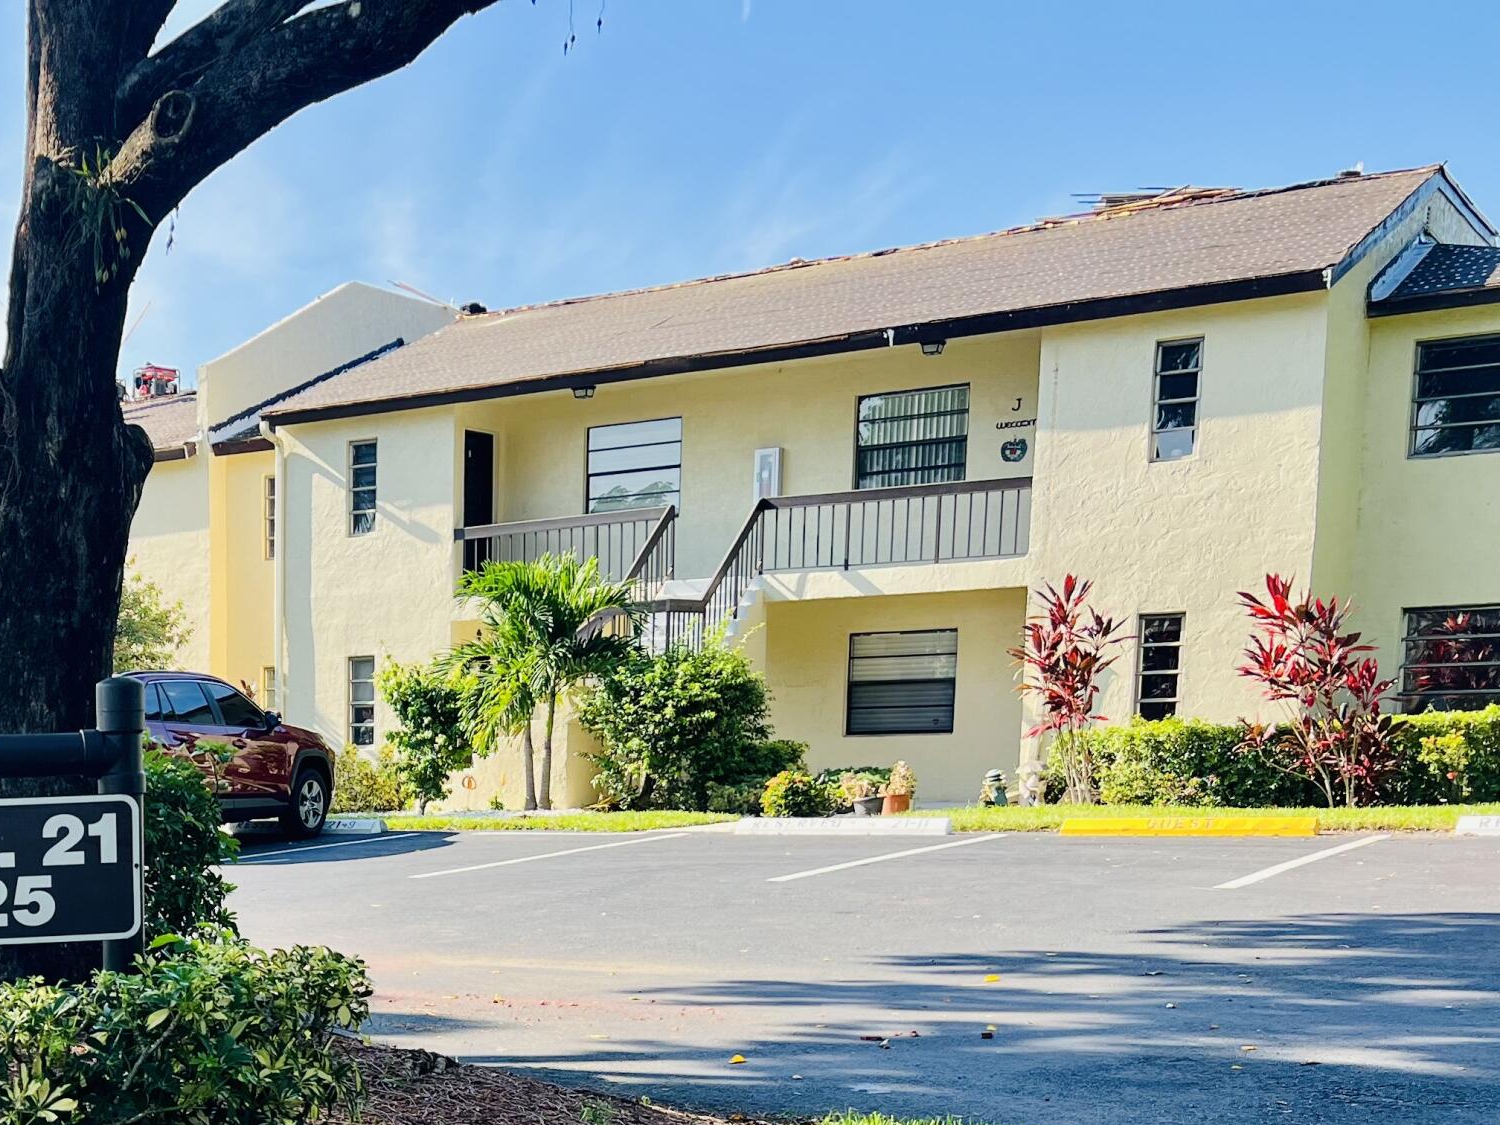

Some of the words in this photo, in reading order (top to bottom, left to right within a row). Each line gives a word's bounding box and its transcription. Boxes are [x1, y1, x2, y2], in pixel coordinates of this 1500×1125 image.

[1011, 397, 1022, 411] J
[1148, 818, 1214, 829] GUEST
[41, 812, 118, 867] 21
